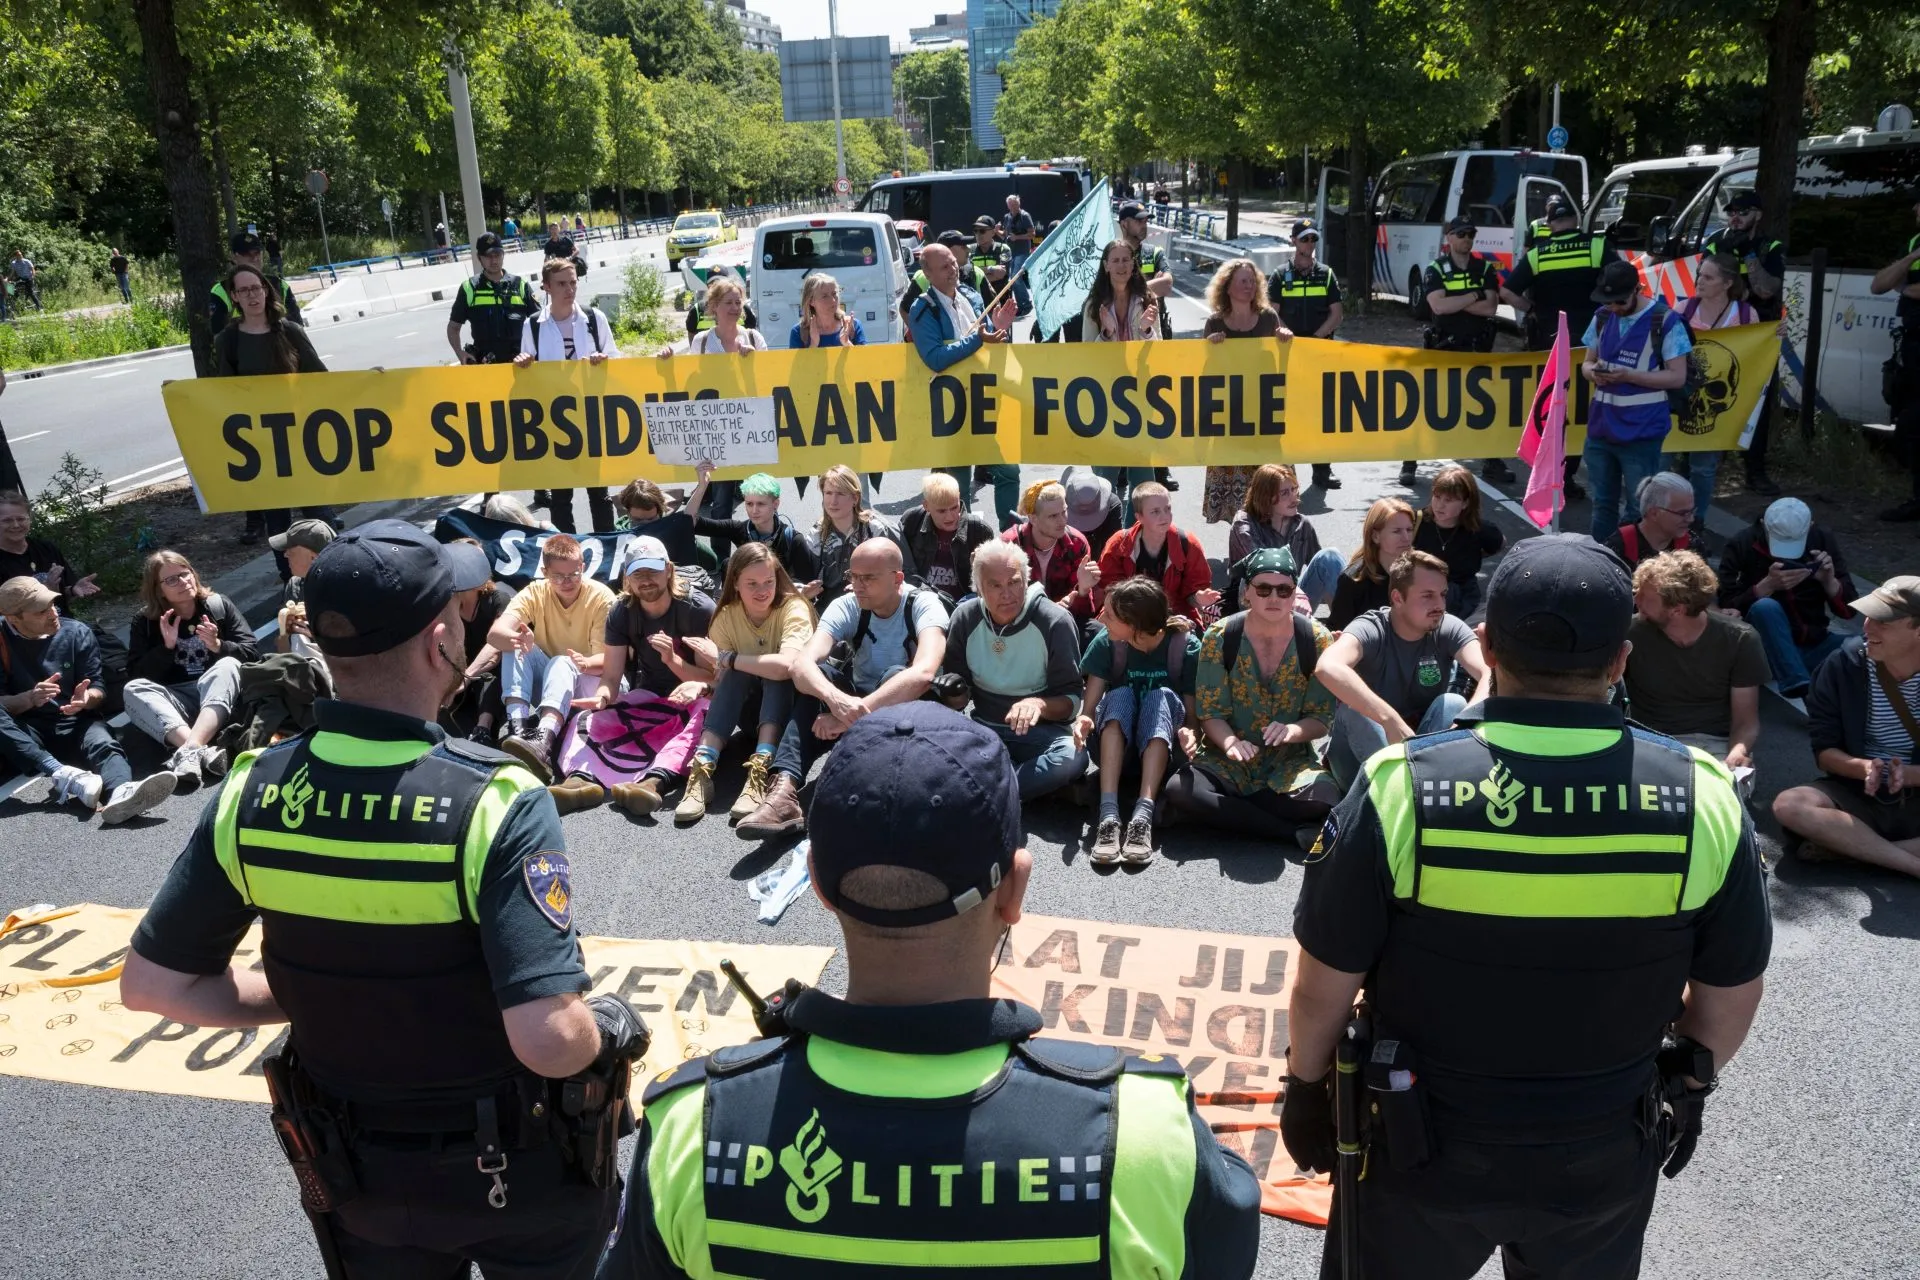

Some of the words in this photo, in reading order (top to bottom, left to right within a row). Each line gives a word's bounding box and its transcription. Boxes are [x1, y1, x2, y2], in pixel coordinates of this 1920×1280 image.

[1544, 241, 1583, 252] POLITIE
[1836, 309, 1896, 331] POLTIE
[645, 406, 653, 418] I
[656, 405, 681, 417] MAY
[685, 404, 697, 416] BE
[702, 402, 755, 416] SUICIDAL,
[222, 407, 393, 482] STOP
[431, 389, 719, 467] SUBSID
[772, 380, 897, 447] AAN
[929, 373, 998, 438] DE
[1032, 373, 1286, 439] FOSSIELE
[1321, 362, 1589, 433] INDUSTI
[648, 420, 666, 433] BUT
[668, 419, 718, 433] TREATING
[720, 417, 744, 430] THE
[651, 433, 680, 446] EARTH
[684, 433, 702, 445] LIKE
[705, 432, 727, 445] THIS
[731, 431, 741, 444] IS
[747, 430, 775, 444] ALSO
[684, 446, 727, 461] SUICIDE
[260, 769, 436, 828] POLITIE
[1456, 770, 1658, 826] POLITIE
[1178, 944, 1288, 995] JIJ
[744, 1122, 1049, 1222] POLITIE
